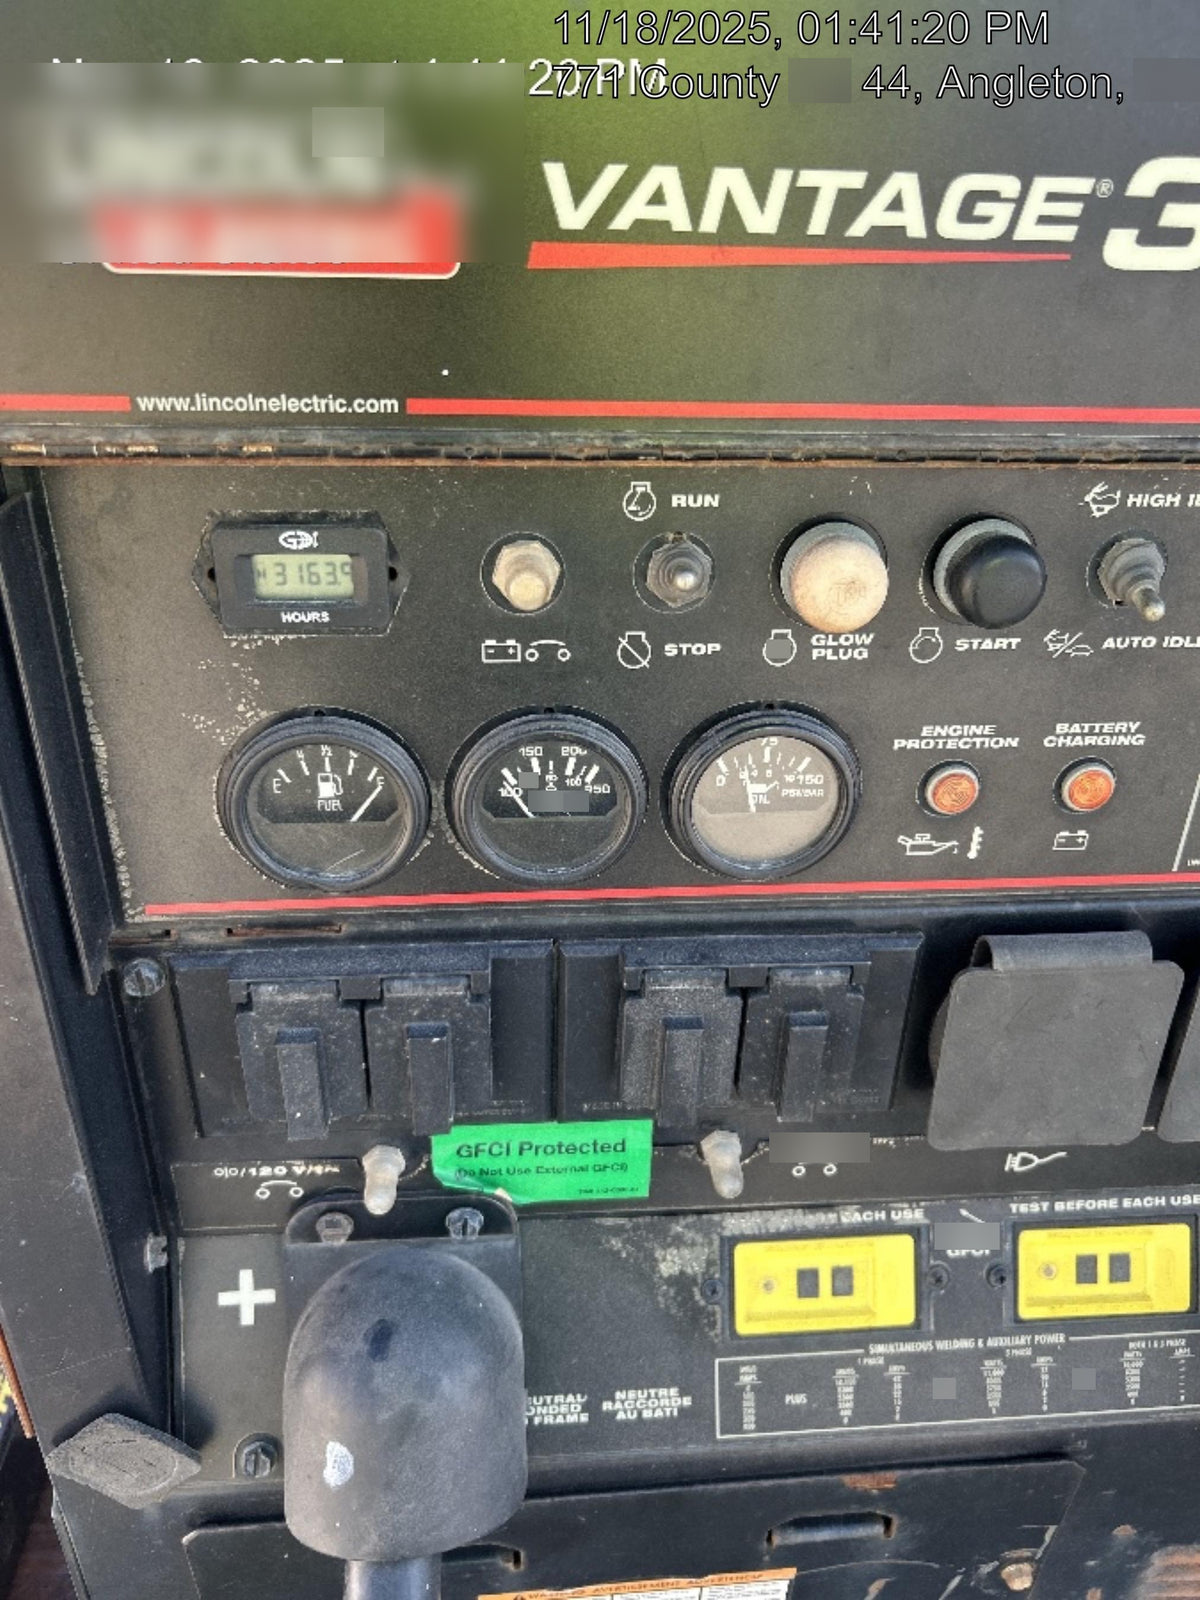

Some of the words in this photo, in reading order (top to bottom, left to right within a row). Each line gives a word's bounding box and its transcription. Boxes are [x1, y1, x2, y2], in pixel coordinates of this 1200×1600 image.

[136, 394, 399, 413] www.lincolnelectric.com
[671, 494, 720, 508] RUN
[1126, 493, 1182, 508] HIGH
[281, 610, 330, 623] HOURS
[811, 633, 875, 646] GLOW
[954, 637, 1022, 651] START
[1101, 636, 1158, 650] AUTO
[664, 642, 722, 656] STOP
[812, 648, 869, 661] PLUG
[921, 725, 997, 737] ENGINE
[1055, 721, 1141, 734] BATTERY
[893, 737, 1019, 750] PROTECTION
[1043, 734, 1146, 747] CHARGING
[518, 746, 543, 757] 150
[273, 778, 281, 793] E
[317, 800, 343, 811] FUEL
[456, 1141, 511, 1158] GFCI
[519, 1138, 626, 1156] Protected
[479, 1166, 503, 1177] Not
[507, 1164, 531, 1176] Use
[536, 1164, 589, 1175] External
[1009, 1202, 1049, 1214] TEST
[1054, 1199, 1118, 1212] BEFORE
[1123, 1196, 1166, 1208] EACH
[1170, 1194, 1200, 1206] USE
[841, 1209, 886, 1222] EACH
[890, 1208, 925, 1220] USE
[868, 1340, 934, 1354] SIMULTANEOUS
[935, 1337, 975, 1350] WELDING
[987, 1335, 1032, 1347] AUXILIARY
[1034, 1332, 1066, 1344] POWER
[615, 1387, 680, 1400] NEUTRE
[785, 1393, 808, 1404] PLUS
[602, 1396, 693, 1412] RACCORDE
[615, 1409, 638, 1420] AU
[642, 1407, 679, 1418] BATI
[534, 1413, 590, 1426] FRAME
